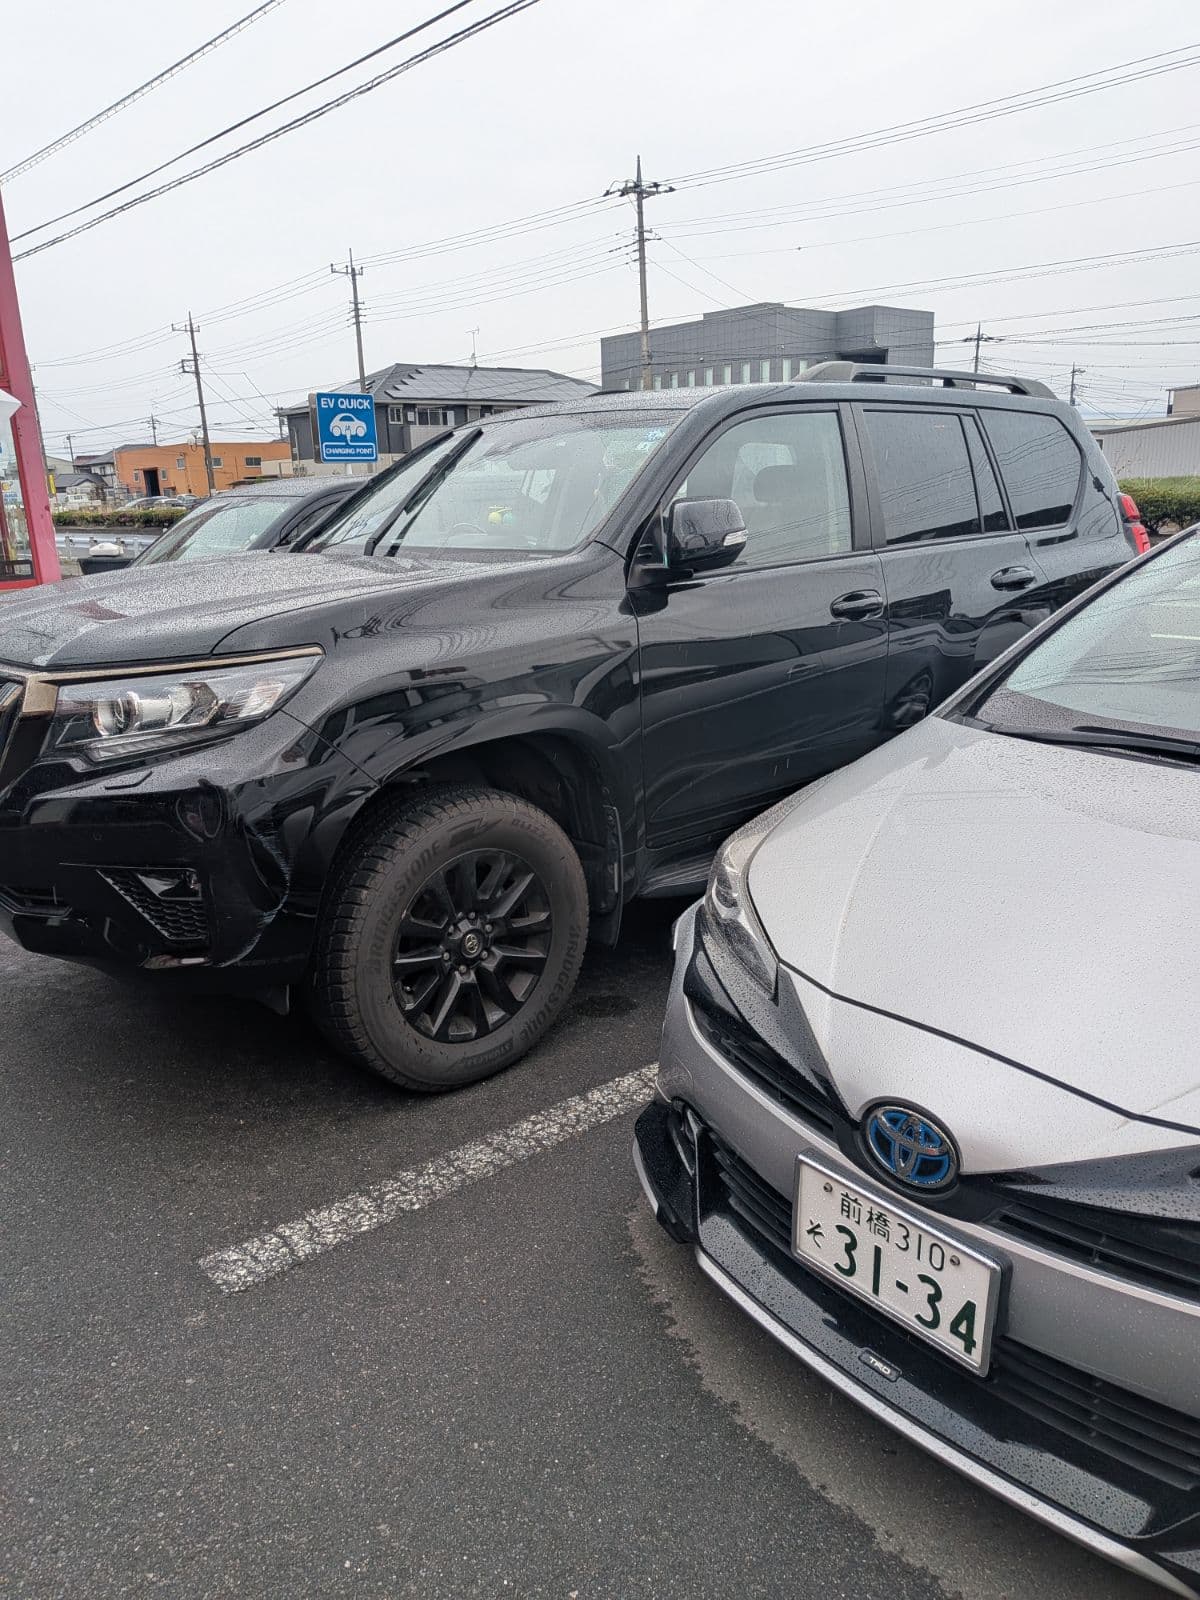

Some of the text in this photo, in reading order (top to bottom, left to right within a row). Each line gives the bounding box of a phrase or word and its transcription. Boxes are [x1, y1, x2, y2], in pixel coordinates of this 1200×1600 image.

[320, 397, 371, 409] EV QUICK
[325, 447, 373, 455] CHARGING POINT
[806, 1219, 977, 1356] そ 31-34
